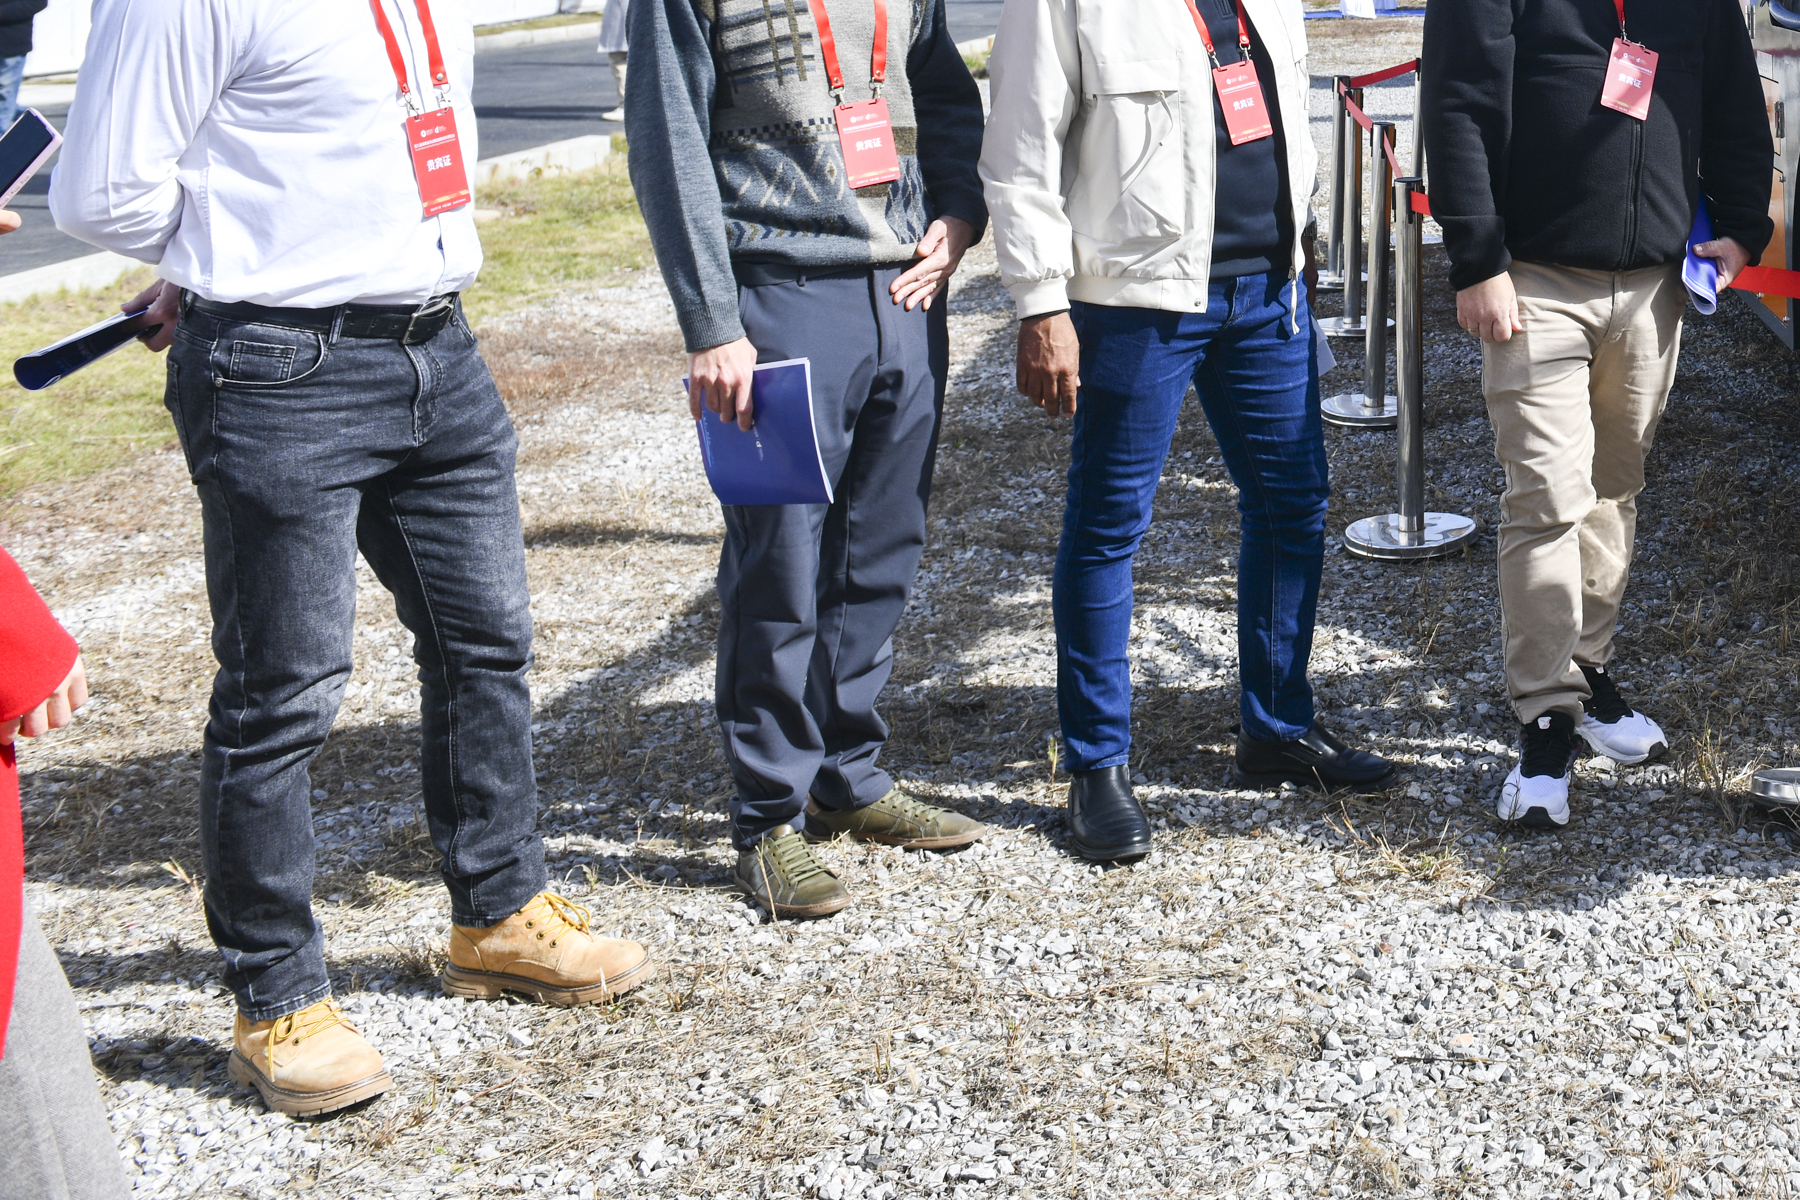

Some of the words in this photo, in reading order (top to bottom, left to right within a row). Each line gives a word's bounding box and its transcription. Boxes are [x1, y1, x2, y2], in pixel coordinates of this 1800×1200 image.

[1233, 97, 1255, 111] 贵宾证
[856, 137, 882, 152] 贵宾证
[427, 154, 452, 172] 贵宾证
